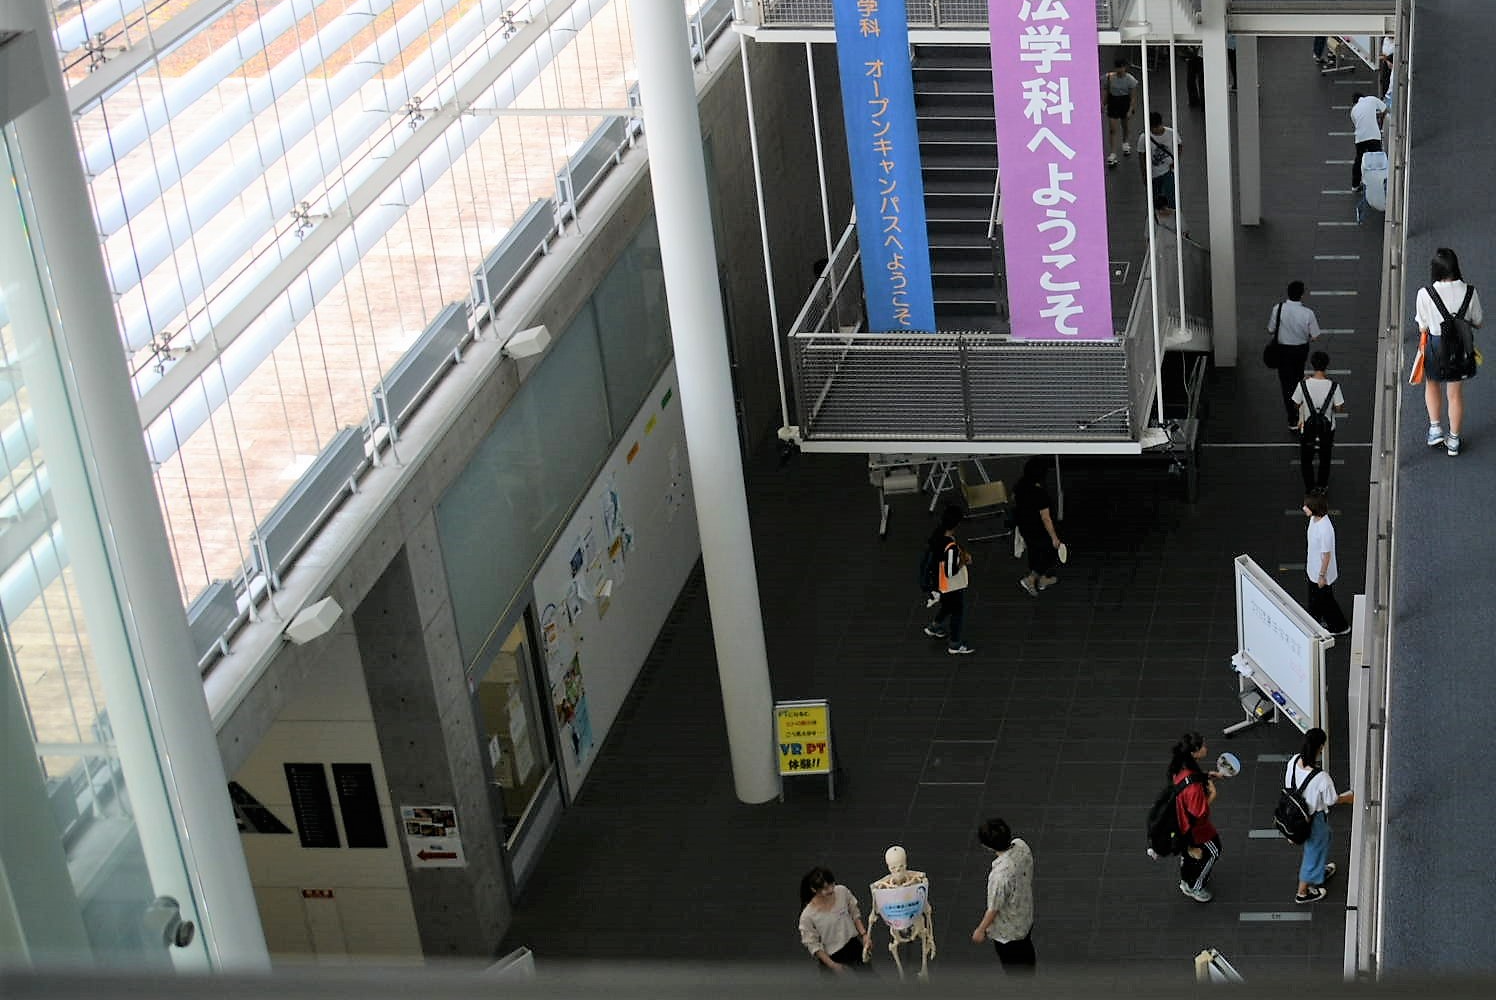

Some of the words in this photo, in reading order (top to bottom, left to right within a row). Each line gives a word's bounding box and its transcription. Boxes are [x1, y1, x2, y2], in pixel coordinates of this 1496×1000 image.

[864, 59, 912, 326] オープンキャンパスへようこそ
[780, 743, 802, 756] VR
[806, 742, 826, 754] PT
